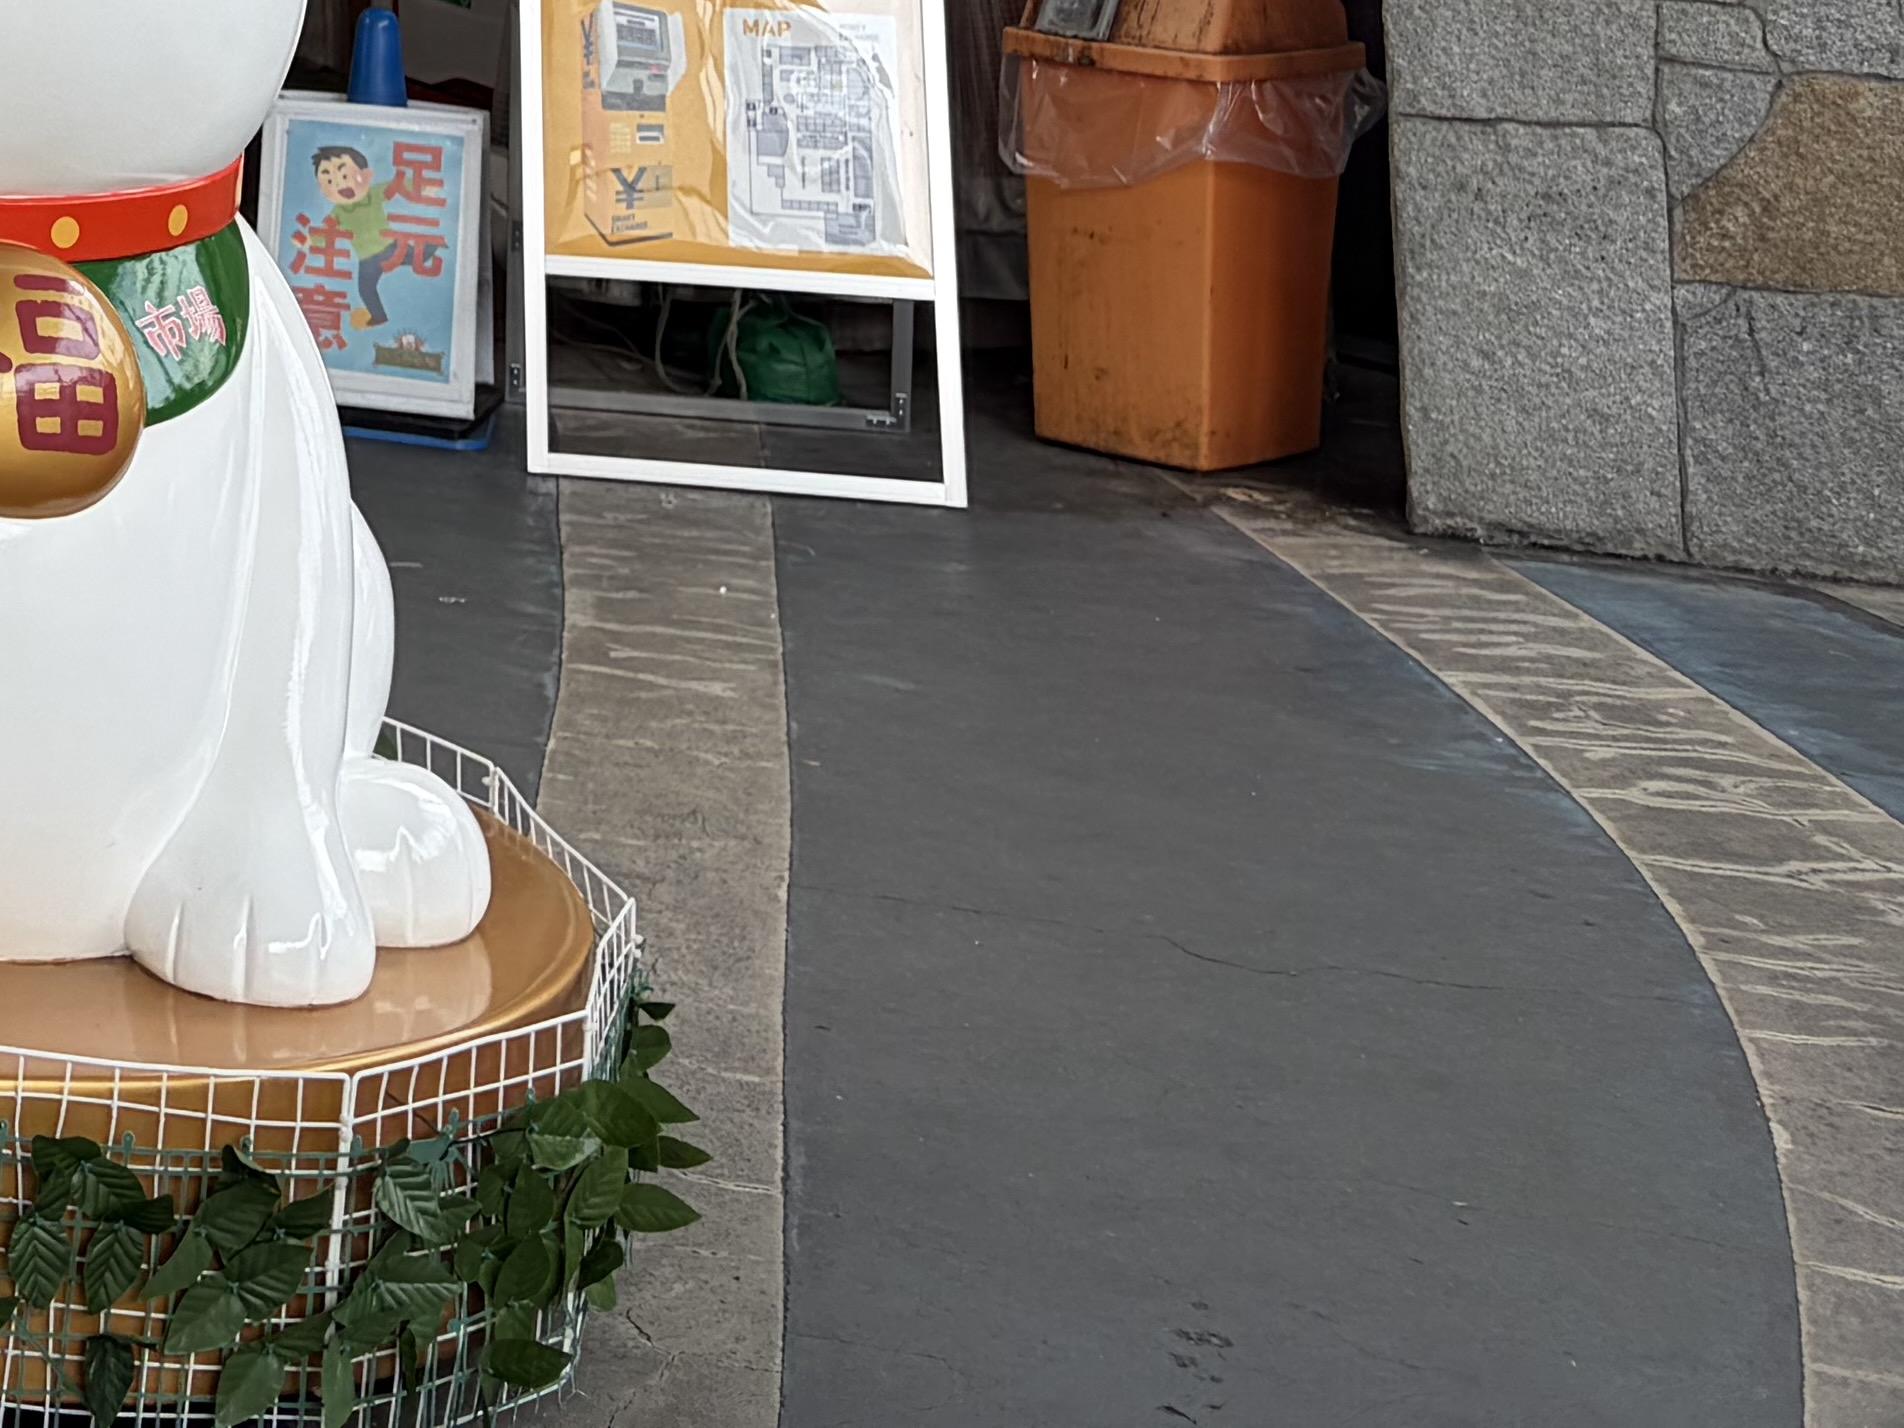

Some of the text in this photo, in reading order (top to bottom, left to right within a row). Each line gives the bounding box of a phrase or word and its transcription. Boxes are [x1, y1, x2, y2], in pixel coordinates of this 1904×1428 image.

[742, 18, 792, 38] MAP
[379, 140, 450, 278] 足元
[135, 284, 229, 360] 市場
[288, 211, 355, 351] 注意
